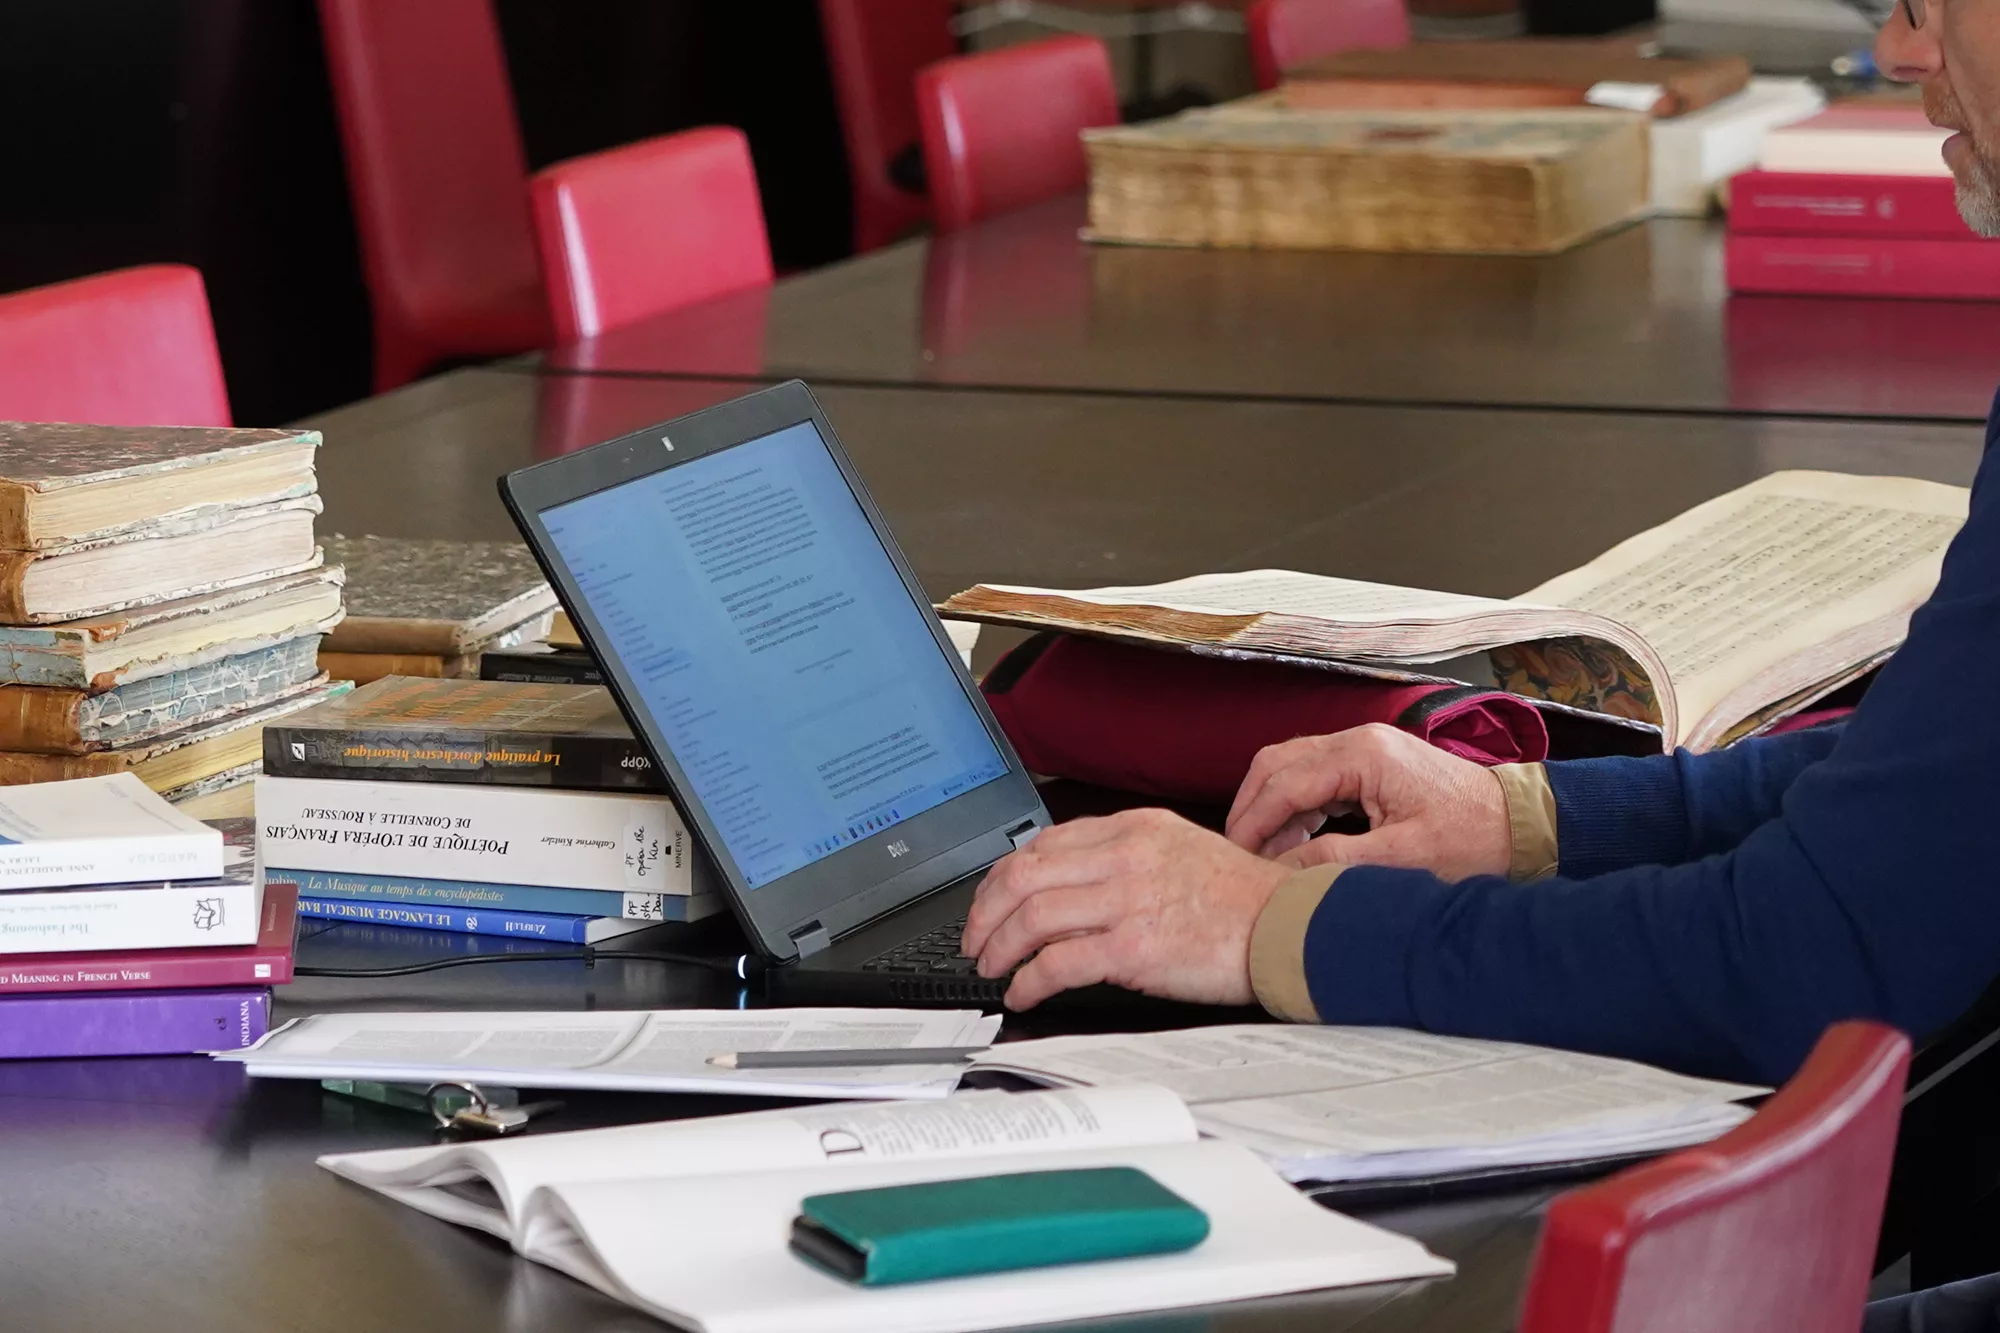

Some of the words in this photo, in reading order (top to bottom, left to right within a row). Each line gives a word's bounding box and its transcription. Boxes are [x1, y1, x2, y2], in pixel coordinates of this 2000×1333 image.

[343, 743, 410, 763] historique
[413, 747, 483, 765] d'orchestre
[486, 749, 541, 766] pratique
[543, 753, 561, 766] La
[301, 807, 365, 823] ROUSSEAU
[379, 813, 452, 830] CORNEILLE
[265, 823, 339, 844] FRANÇAIS
[408, 834, 429, 848] DE
[540, 836, 573, 847] Kintzler
[432, 832, 510, 855] POÉTIQUE
[575, 839, 616, 850] Catherine
[674, 829, 684, 869] MINERVE
[307, 875, 323, 890] La
[324, 877, 368, 895] Musique
[369, 883, 384, 893] au
[386, 881, 413, 899] temps
[416, 883, 432, 897] des
[434, 884, 505, 903] encyclopédistes
[322, 903, 375, 919] MUSICAL
[376, 908, 434, 925] LANGAGE
[434, 914, 452, 926] LE
[11, 972, 60, 984] MEANING
[62, 973, 75, 983] IN
[77, 971, 118, 982] FRENCH
[119, 969, 152, 980] VERSE
[240, 1000, 250, 1046] INDIANA
